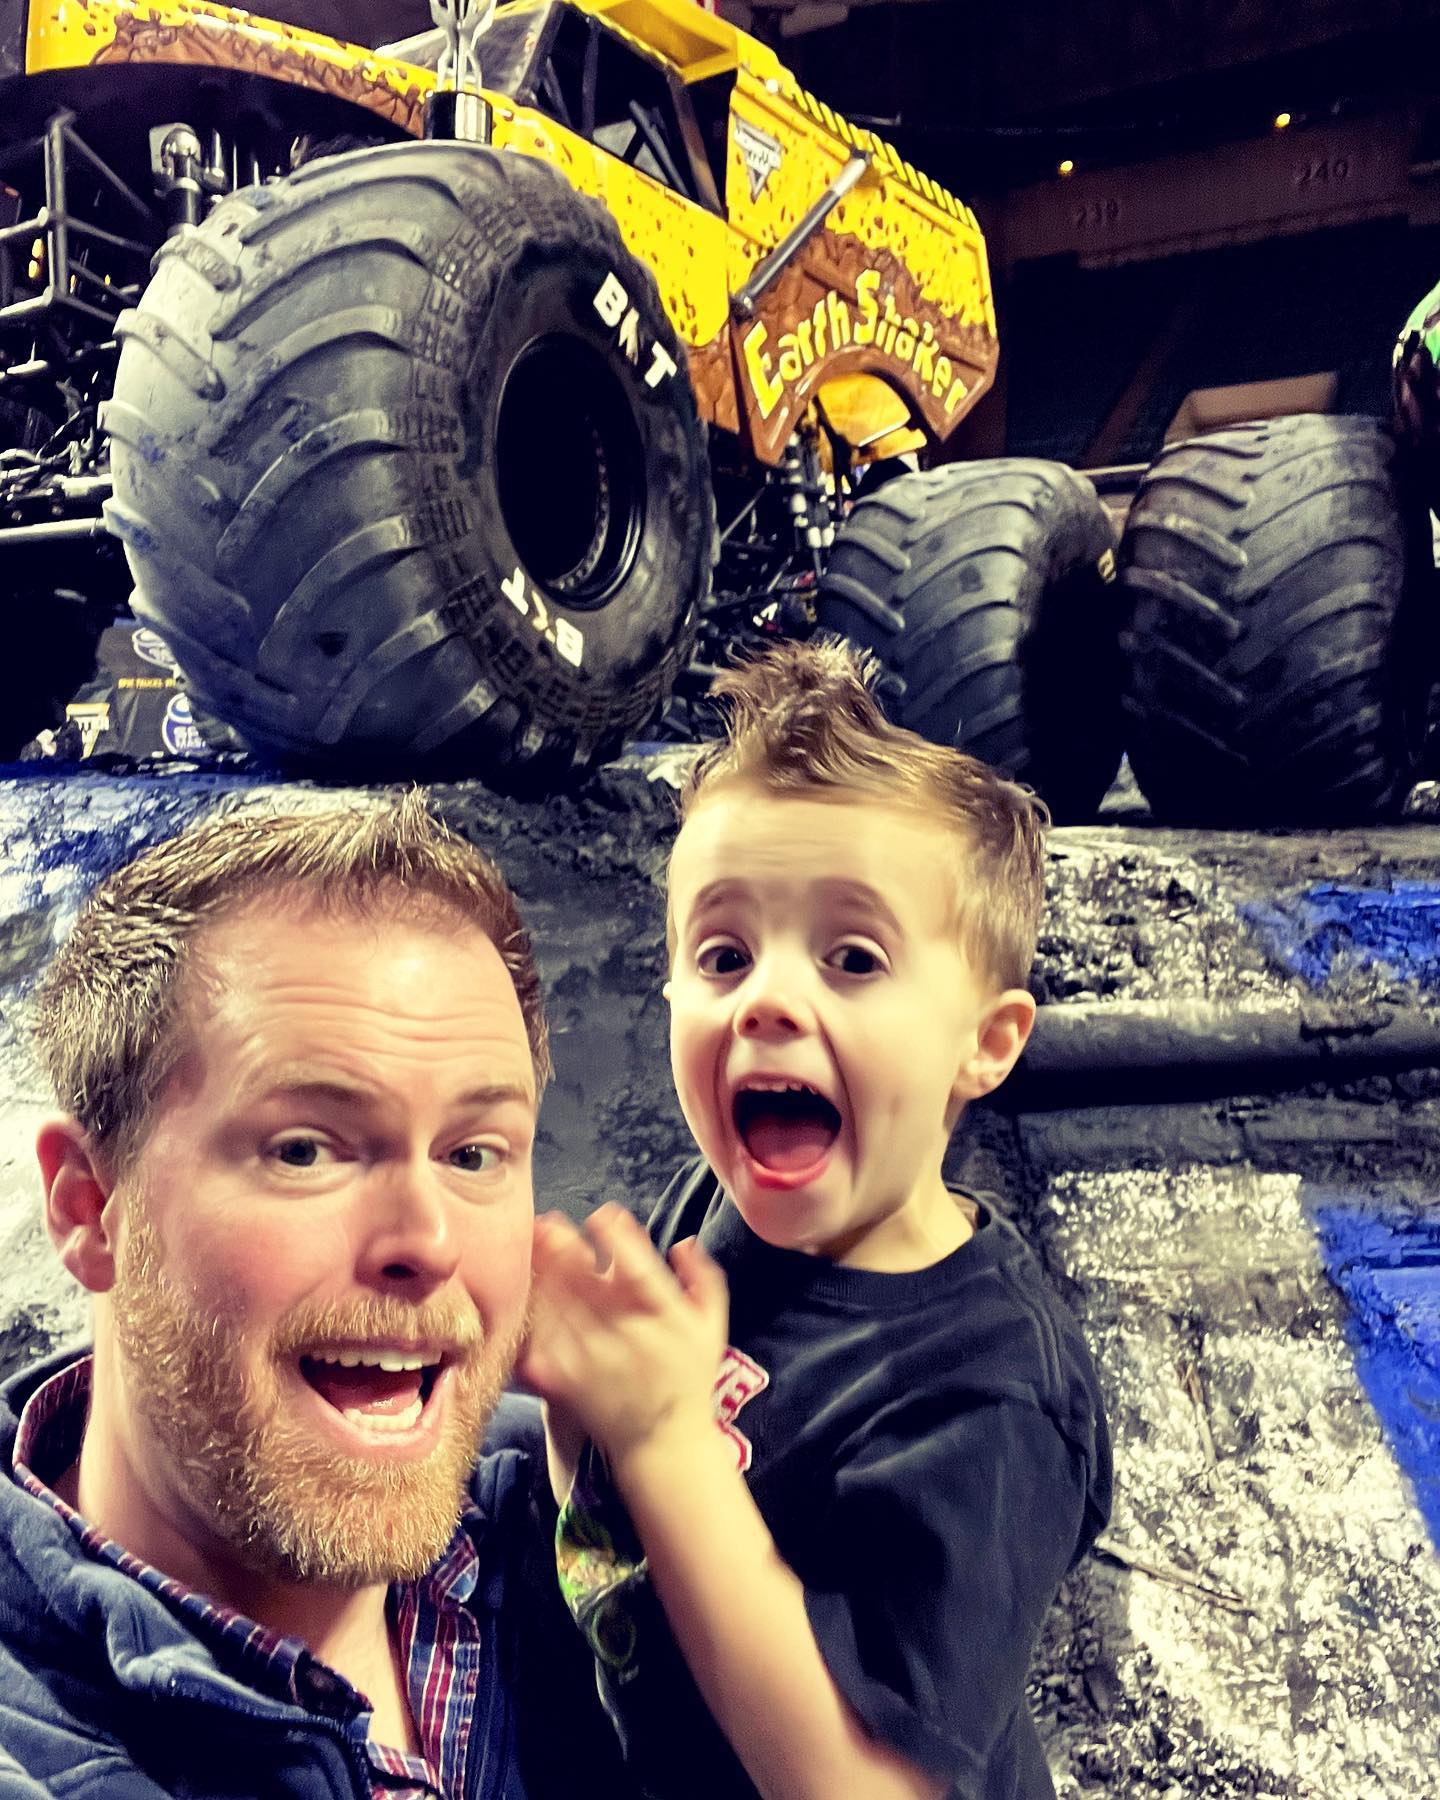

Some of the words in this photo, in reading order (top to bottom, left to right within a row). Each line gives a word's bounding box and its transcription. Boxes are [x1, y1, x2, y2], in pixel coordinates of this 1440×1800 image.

[1298, 159, 1349, 185] 240
[743, 290, 851, 420] Earth
[853, 268, 968, 415] Shaker
